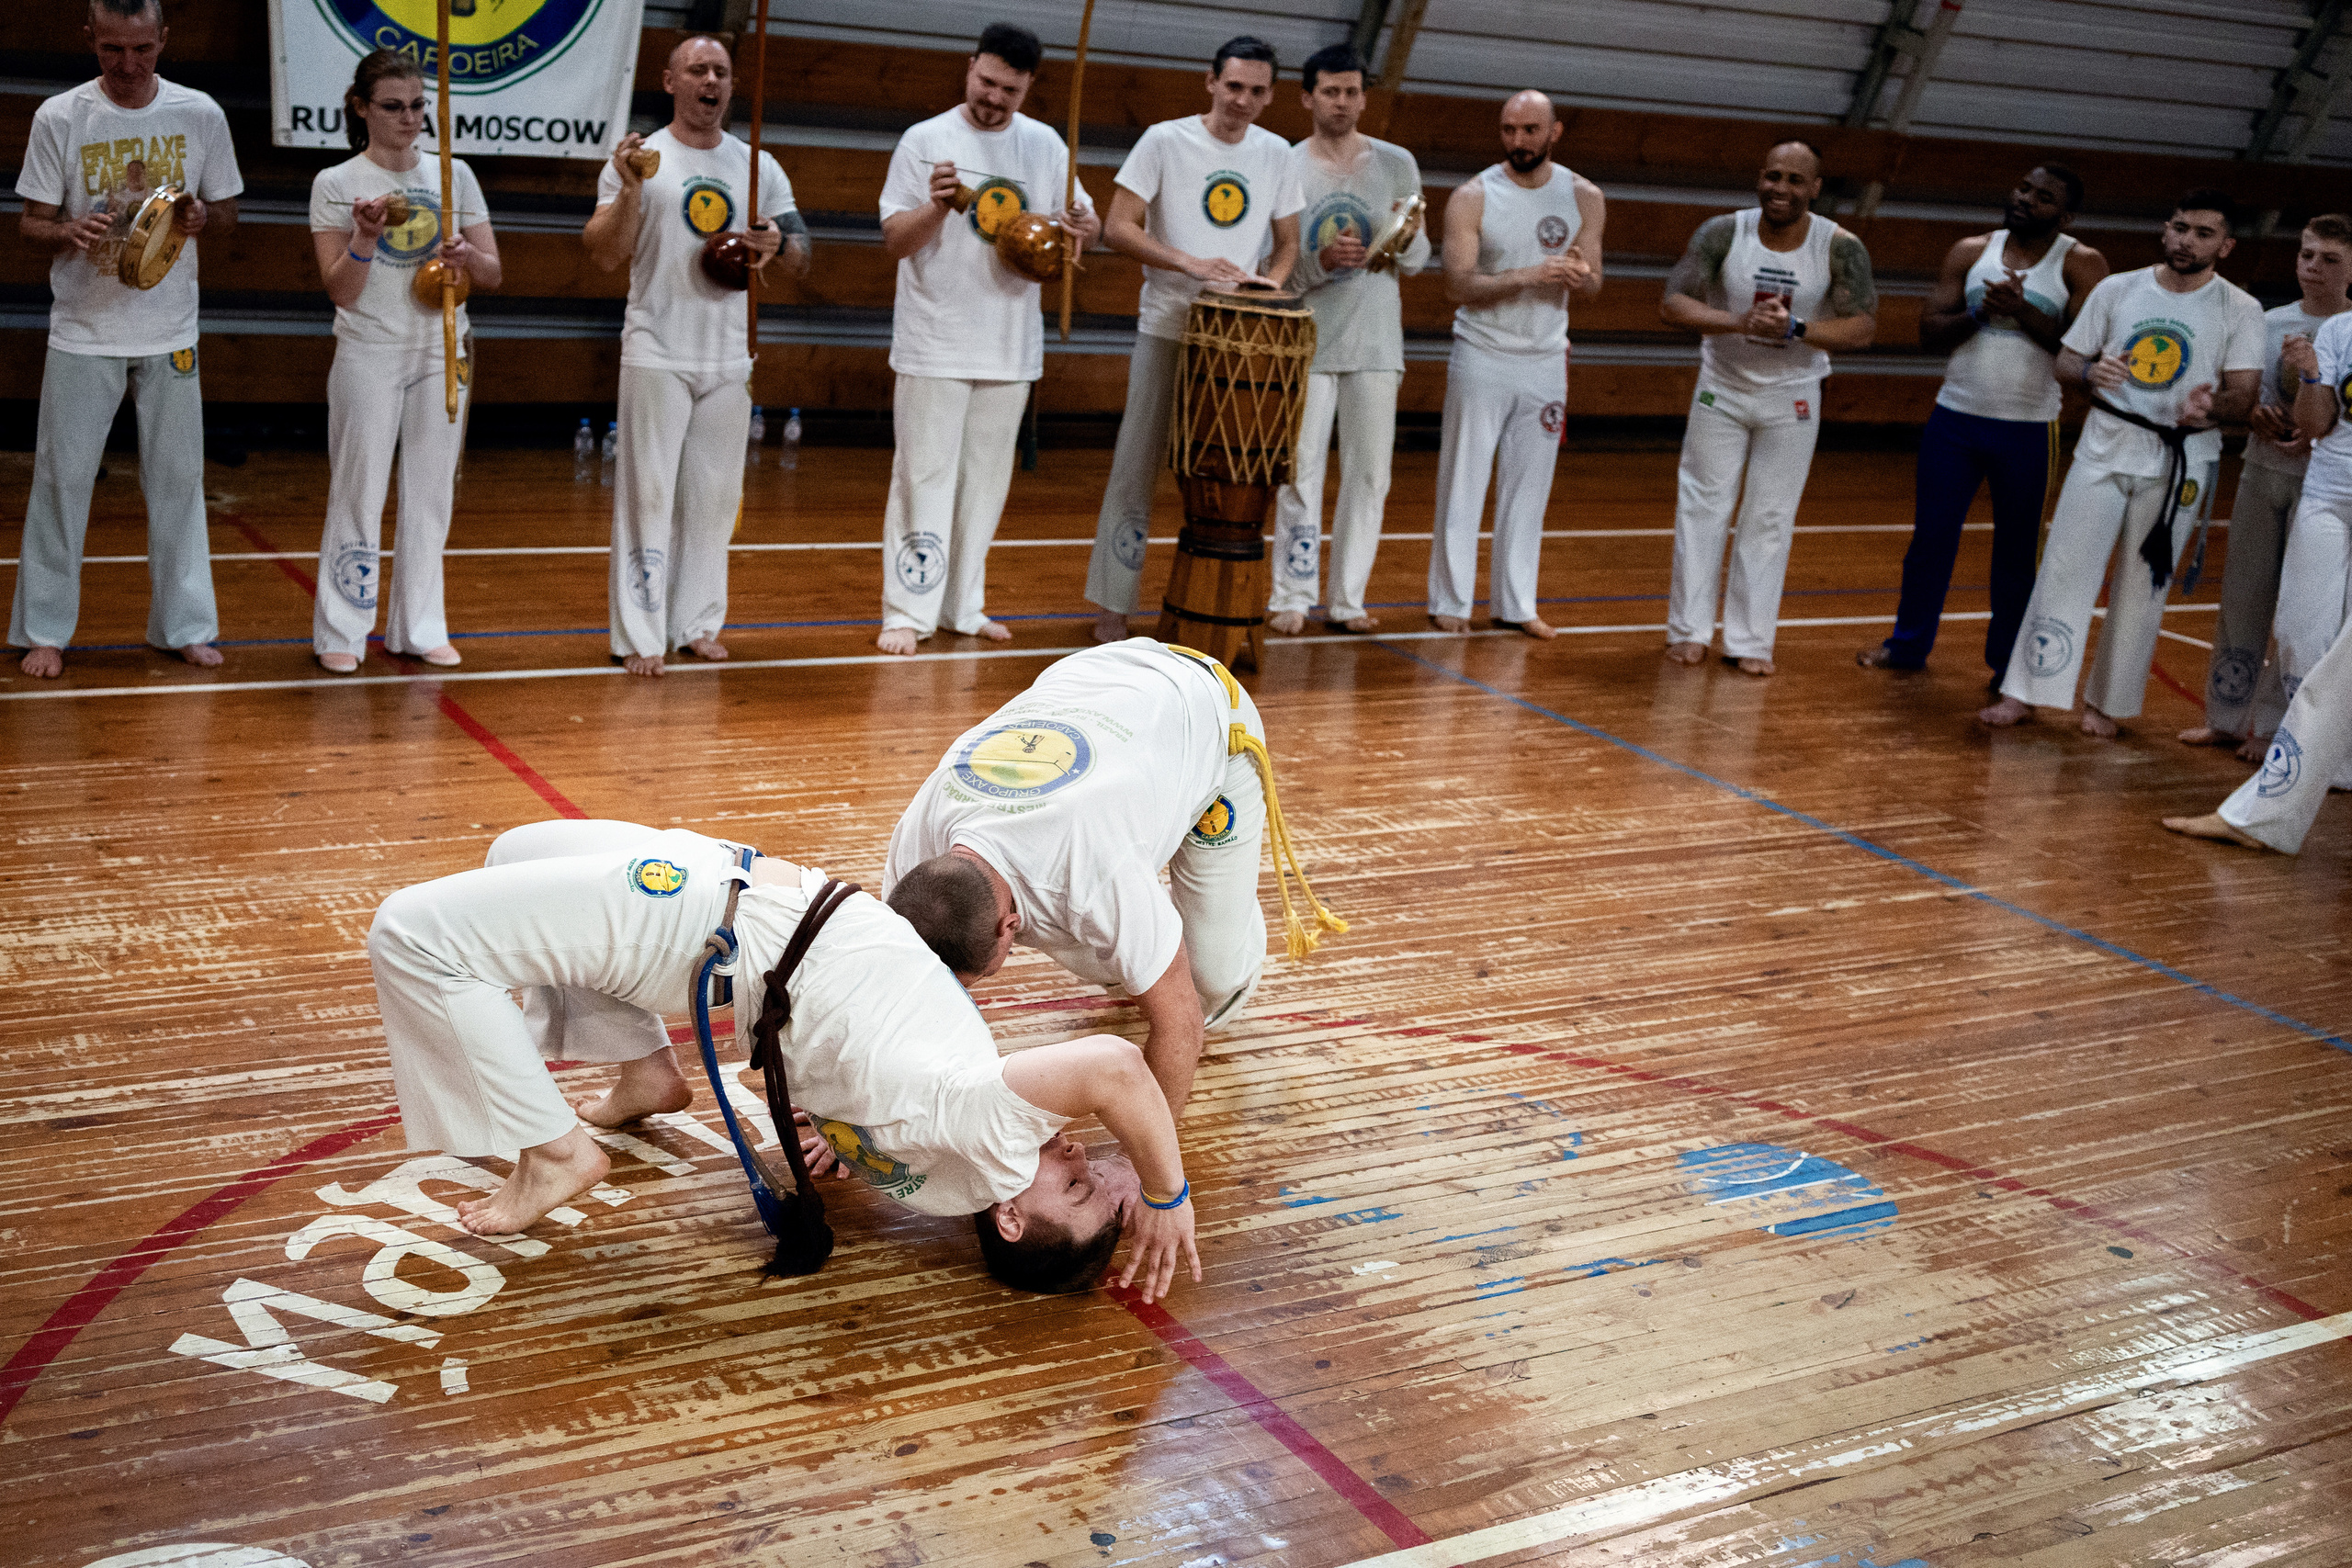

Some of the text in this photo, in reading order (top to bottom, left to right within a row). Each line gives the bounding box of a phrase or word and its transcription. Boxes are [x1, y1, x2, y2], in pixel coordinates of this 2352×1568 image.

[375, 26, 539, 75] CAPOEIRA
[1009, 720, 1080, 740] CAPOEIRA
[988, 787, 1041, 798] GRUPO
